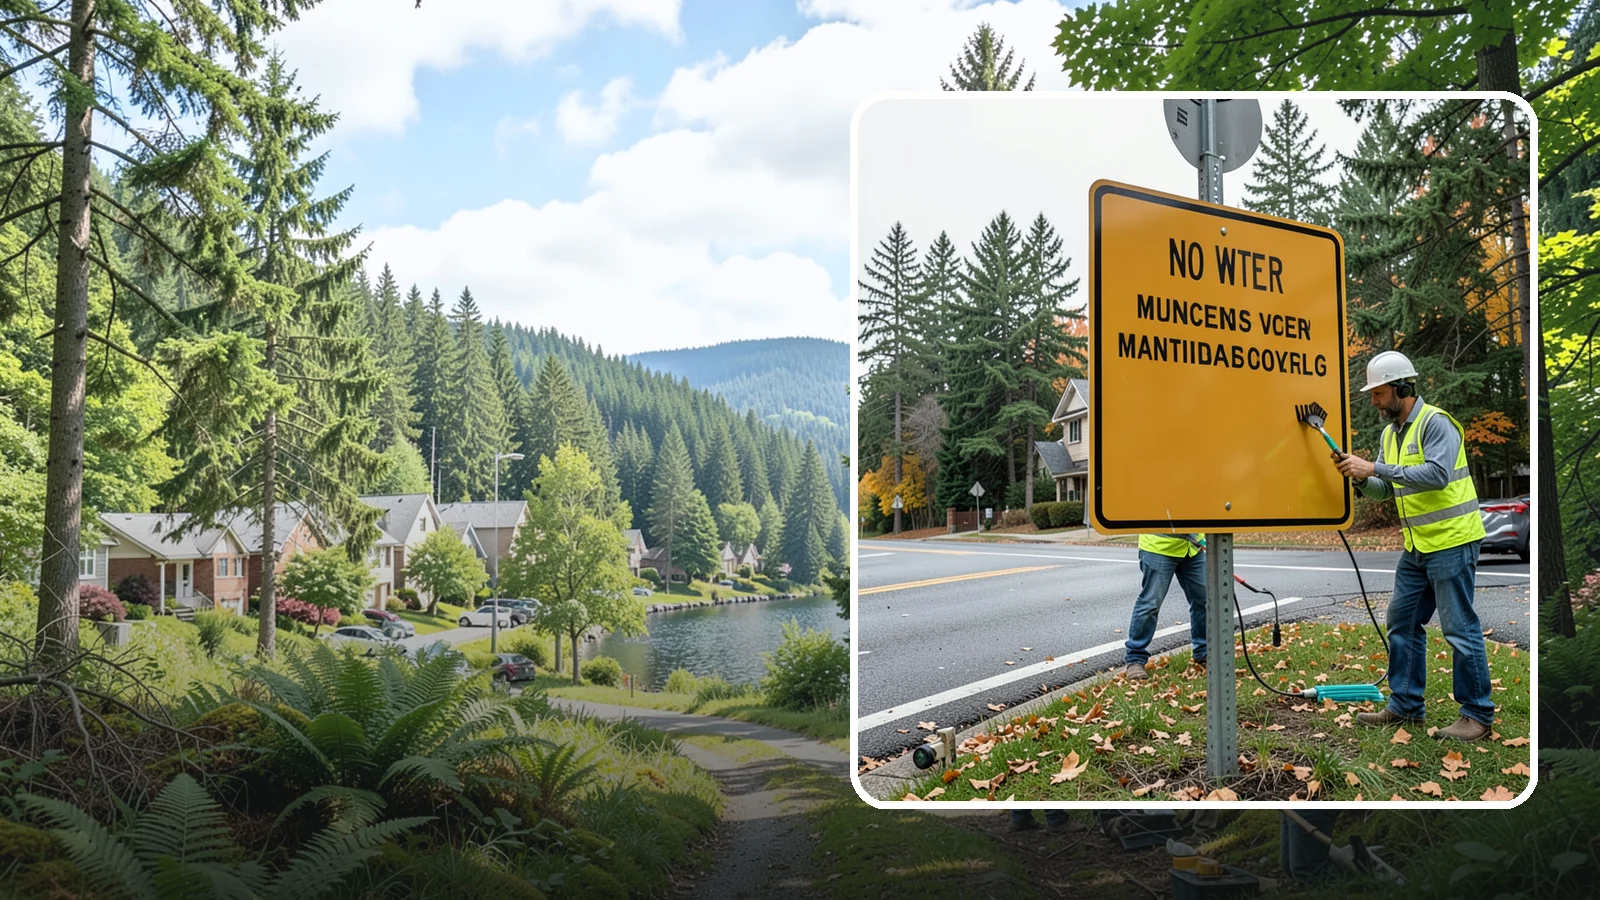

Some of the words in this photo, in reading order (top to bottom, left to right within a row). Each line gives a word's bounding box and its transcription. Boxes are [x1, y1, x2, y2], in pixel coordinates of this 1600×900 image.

[1169, 238, 1204, 281] NO
[1215, 245, 1284, 294] WTER
[1137, 294, 1252, 333] MUNCENS
